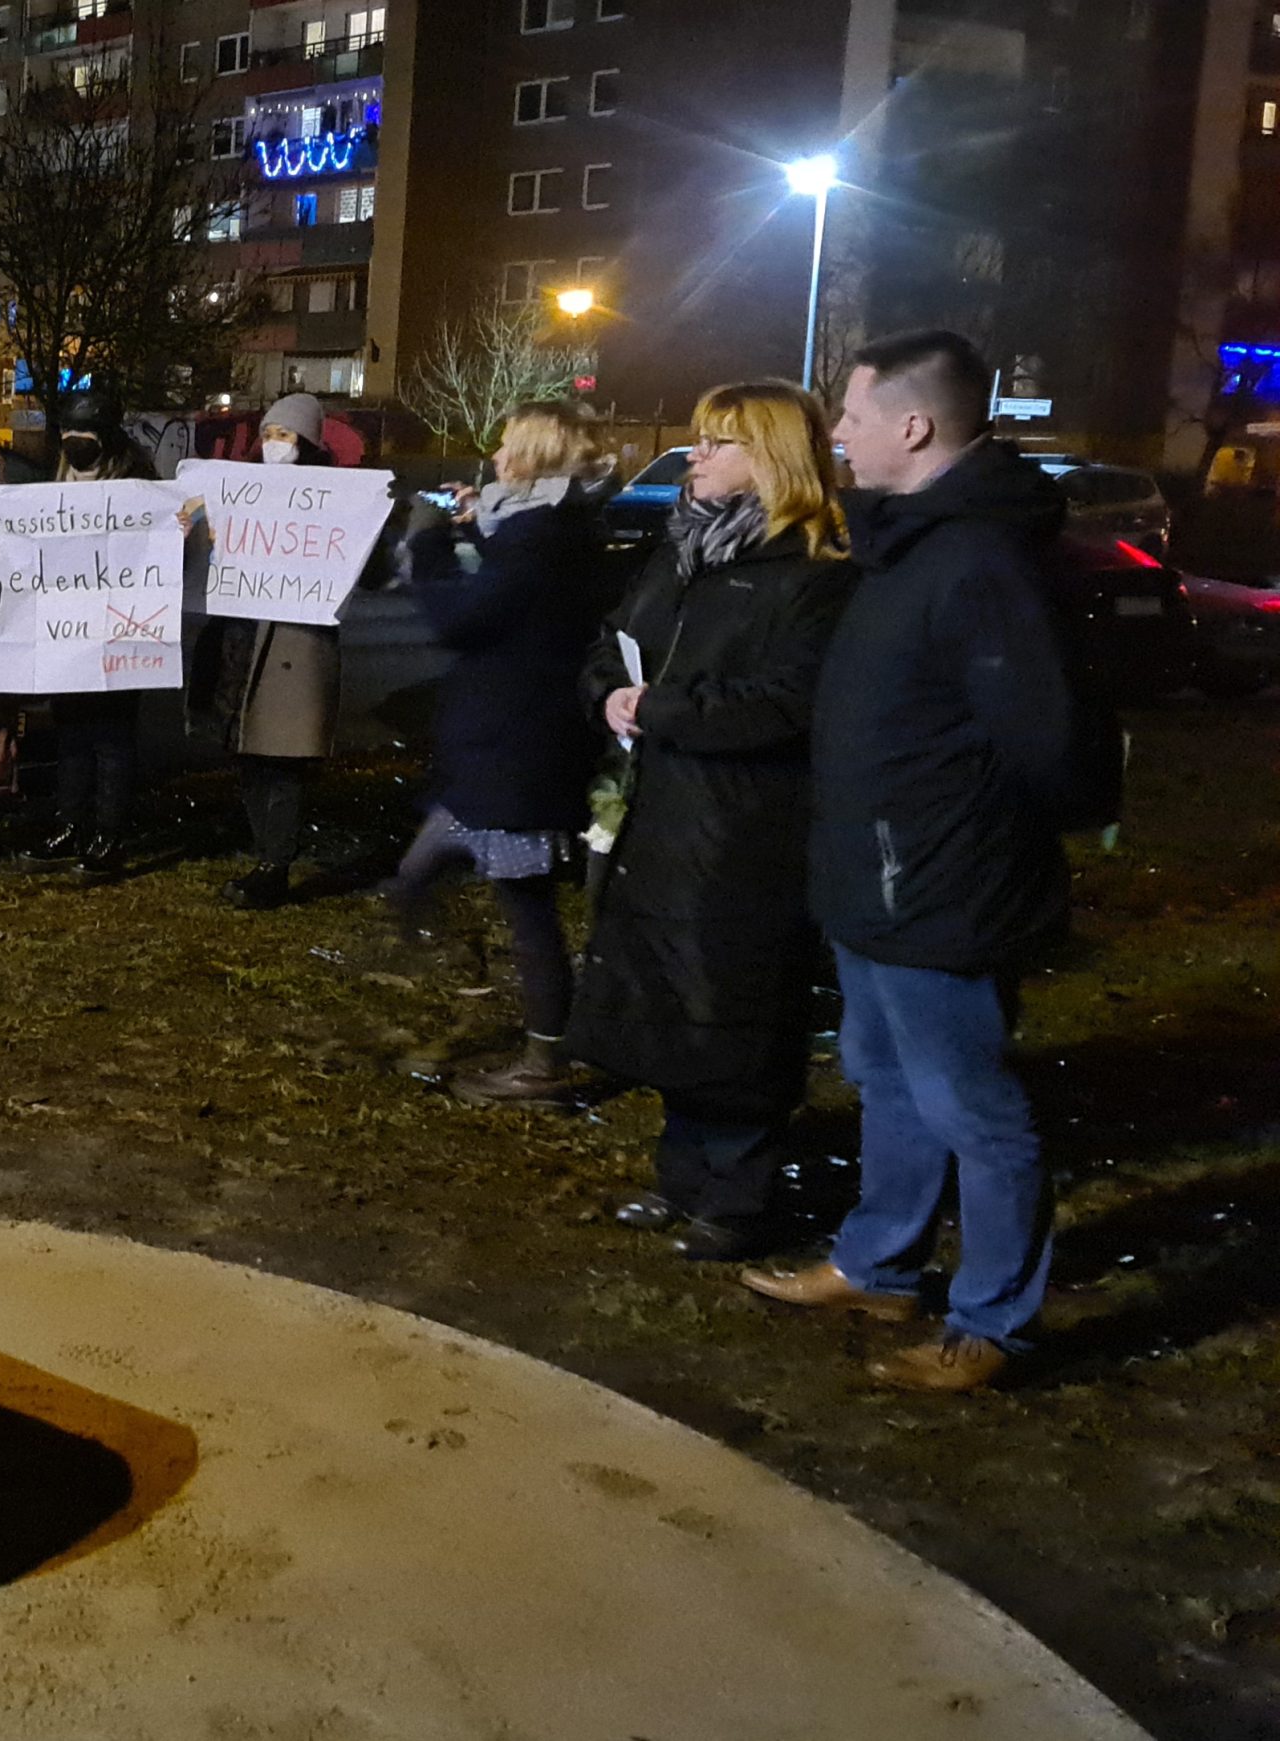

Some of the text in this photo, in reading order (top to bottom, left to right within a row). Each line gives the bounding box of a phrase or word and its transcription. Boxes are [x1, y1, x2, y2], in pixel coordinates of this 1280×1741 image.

[221, 477, 332, 511] WO IST
[225, 514, 346, 561] UNSER
[46, 619, 90, 640] von
[102, 644, 164, 674] unten
